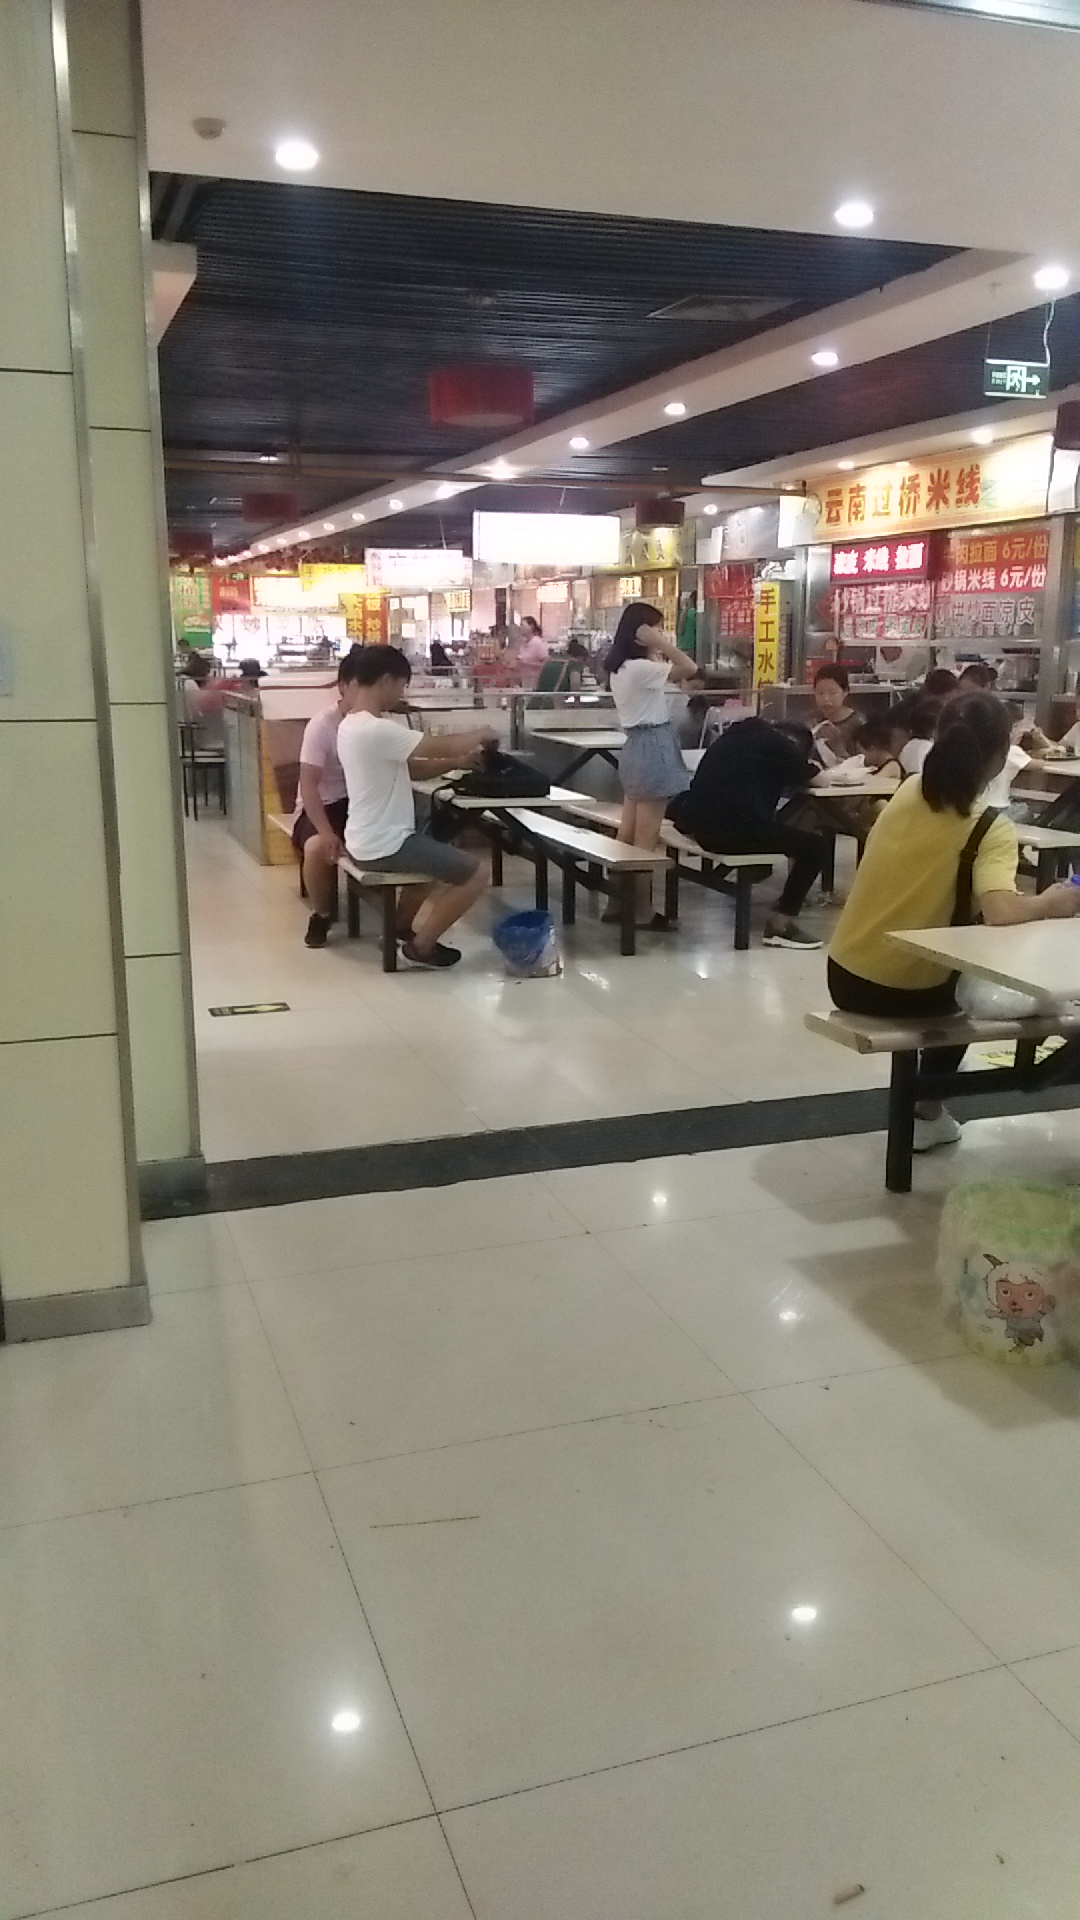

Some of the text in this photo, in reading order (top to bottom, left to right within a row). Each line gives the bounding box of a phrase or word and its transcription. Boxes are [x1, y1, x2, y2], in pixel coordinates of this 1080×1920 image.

[825, 464, 981, 526] 云南过桥米线
[1002, 536, 1049, 560] 6元/份
[1000, 563, 1047, 589] 6元/份
